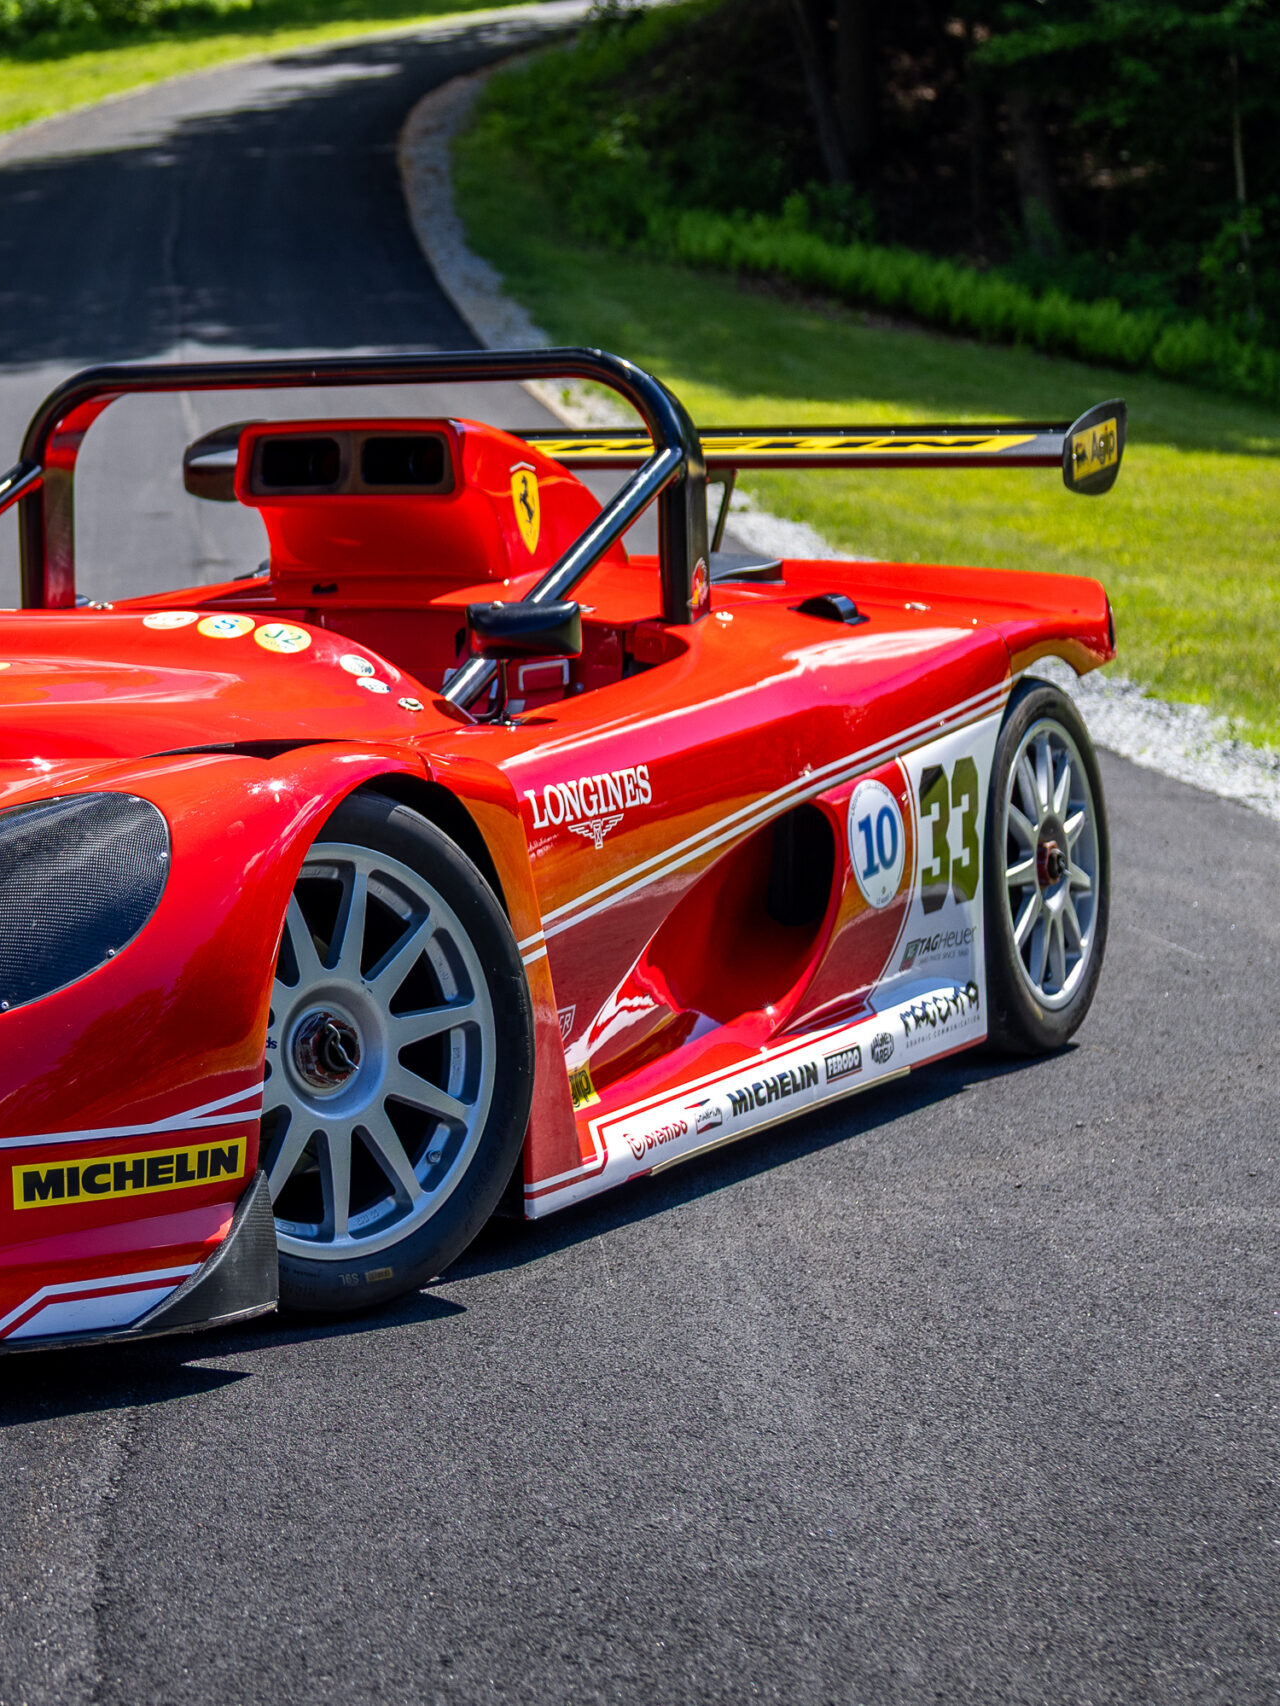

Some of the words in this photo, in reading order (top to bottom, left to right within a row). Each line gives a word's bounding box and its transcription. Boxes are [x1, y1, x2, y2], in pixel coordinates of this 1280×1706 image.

[523, 765, 653, 829] LONGINES
[858, 804, 898, 880] 10
[919, 756, 980, 915] 33
[569, 1067, 592, 1108] gip
[726, 1061, 819, 1117] MICHELIN
[827, 1049, 859, 1076] FERODO
[23, 1145, 239, 1202] MICHELIN
